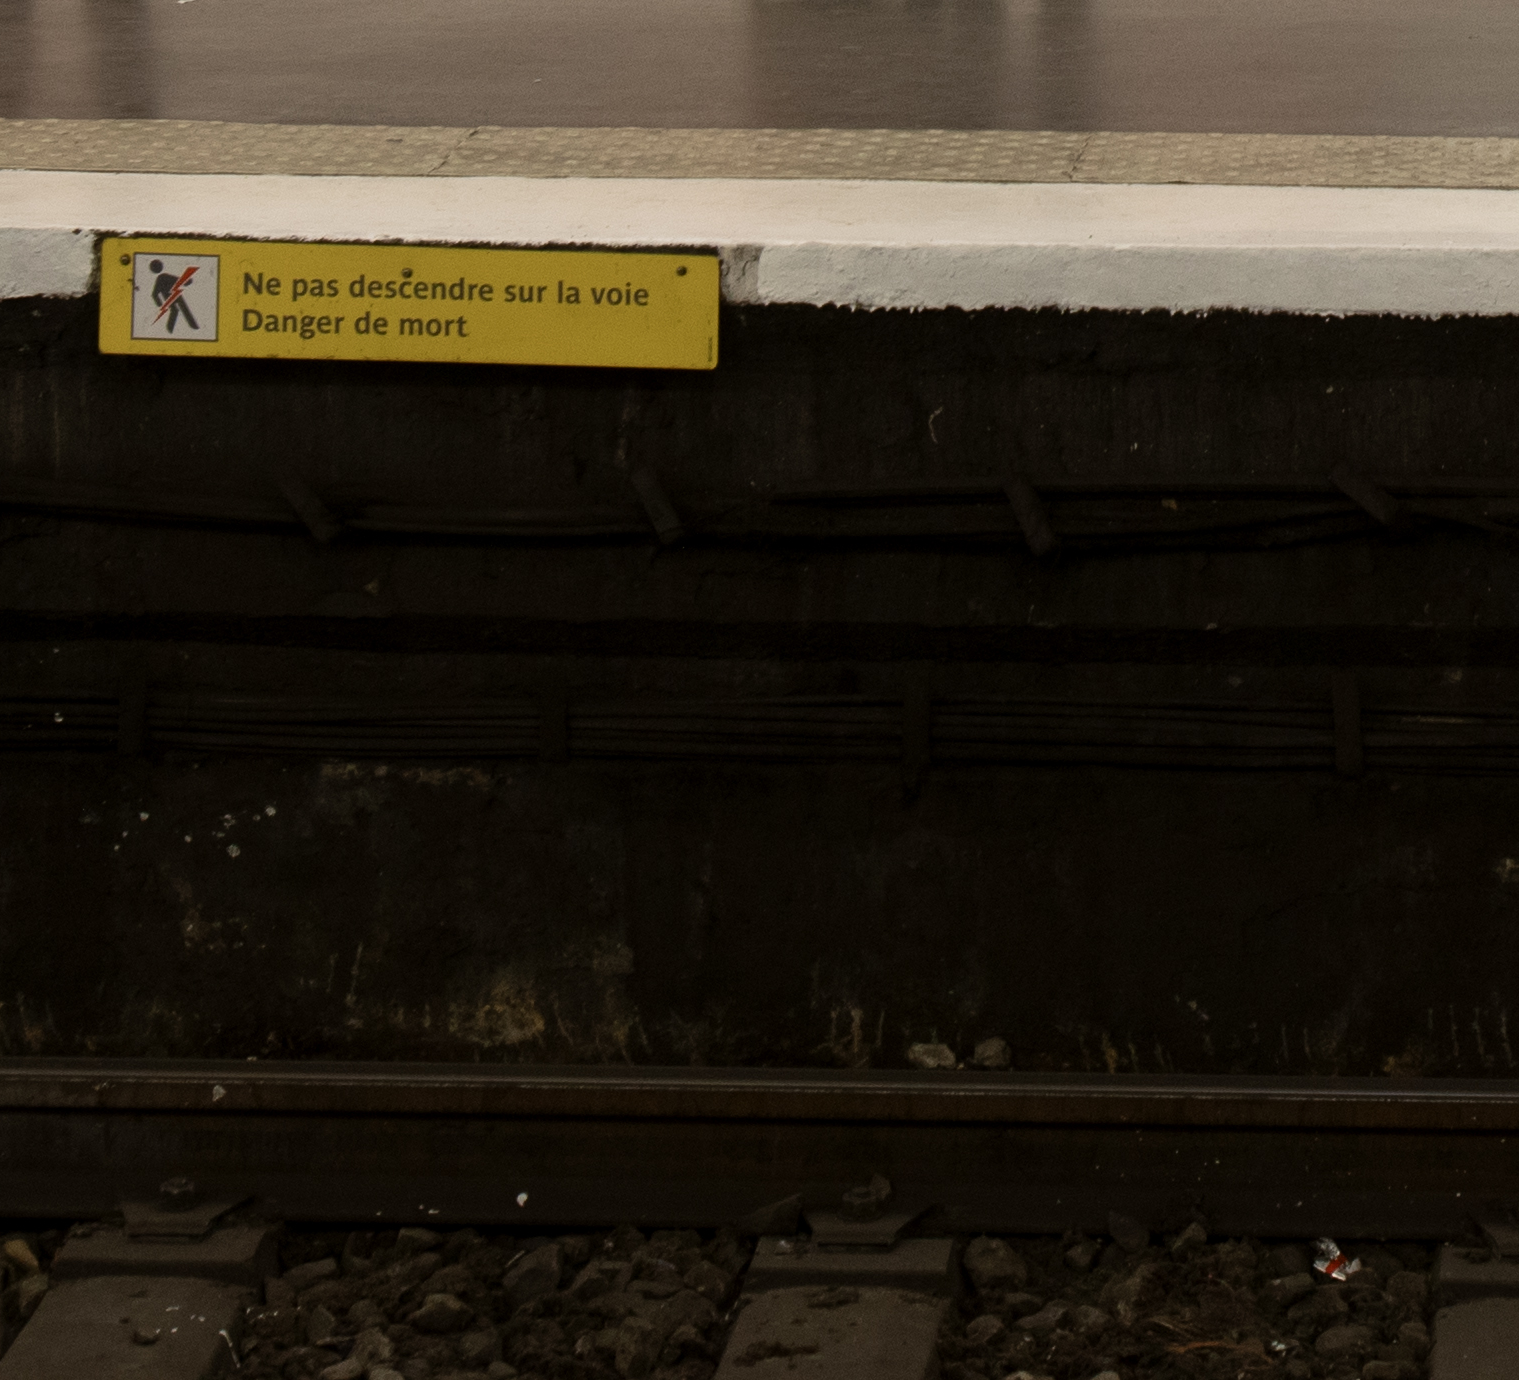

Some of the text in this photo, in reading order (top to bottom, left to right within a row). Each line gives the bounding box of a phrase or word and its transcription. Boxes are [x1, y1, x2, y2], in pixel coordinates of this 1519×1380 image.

[242, 272, 650, 308] Ne pas descendre sur la voie
[241, 307, 468, 340] Danger de mort
